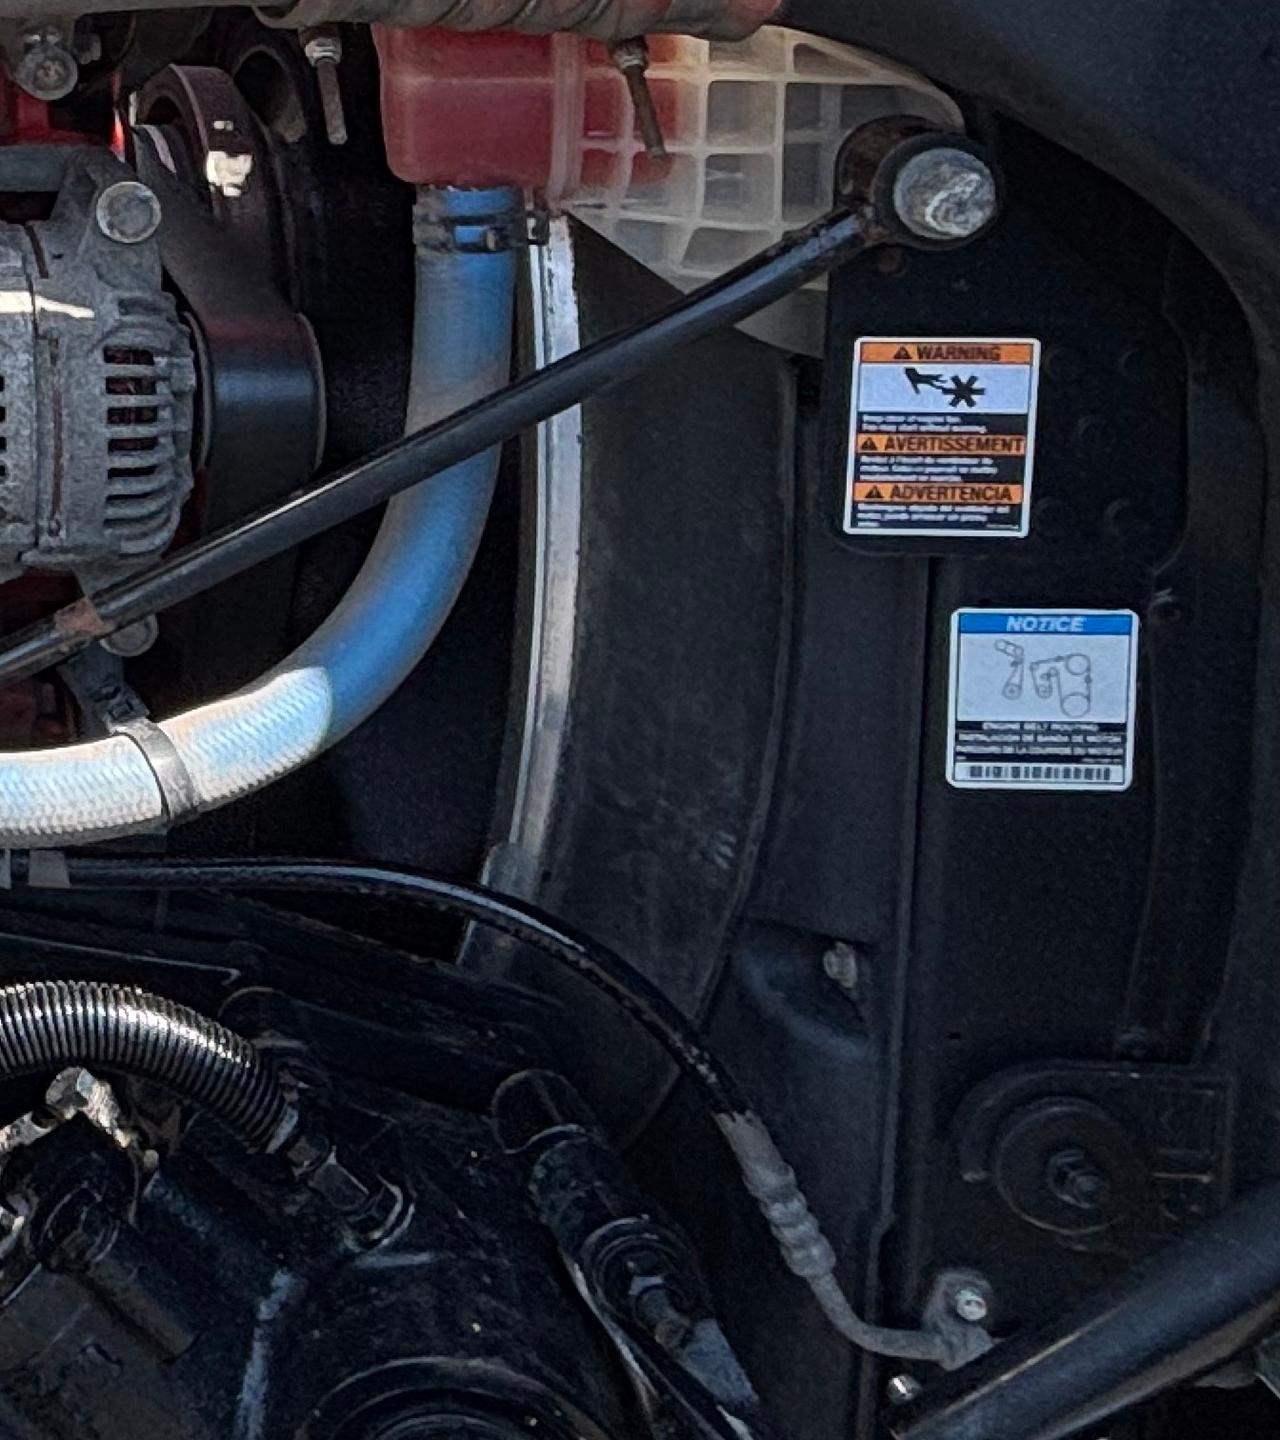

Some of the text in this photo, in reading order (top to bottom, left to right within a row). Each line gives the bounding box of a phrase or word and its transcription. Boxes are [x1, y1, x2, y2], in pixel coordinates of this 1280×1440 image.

[917, 346, 1001, 360] WARNING
[884, 437, 1024, 452] AVERTISSEMENT
[890, 485, 1013, 501] ADVERTENCIA
[1006, 616, 1087, 632] NOTICE
